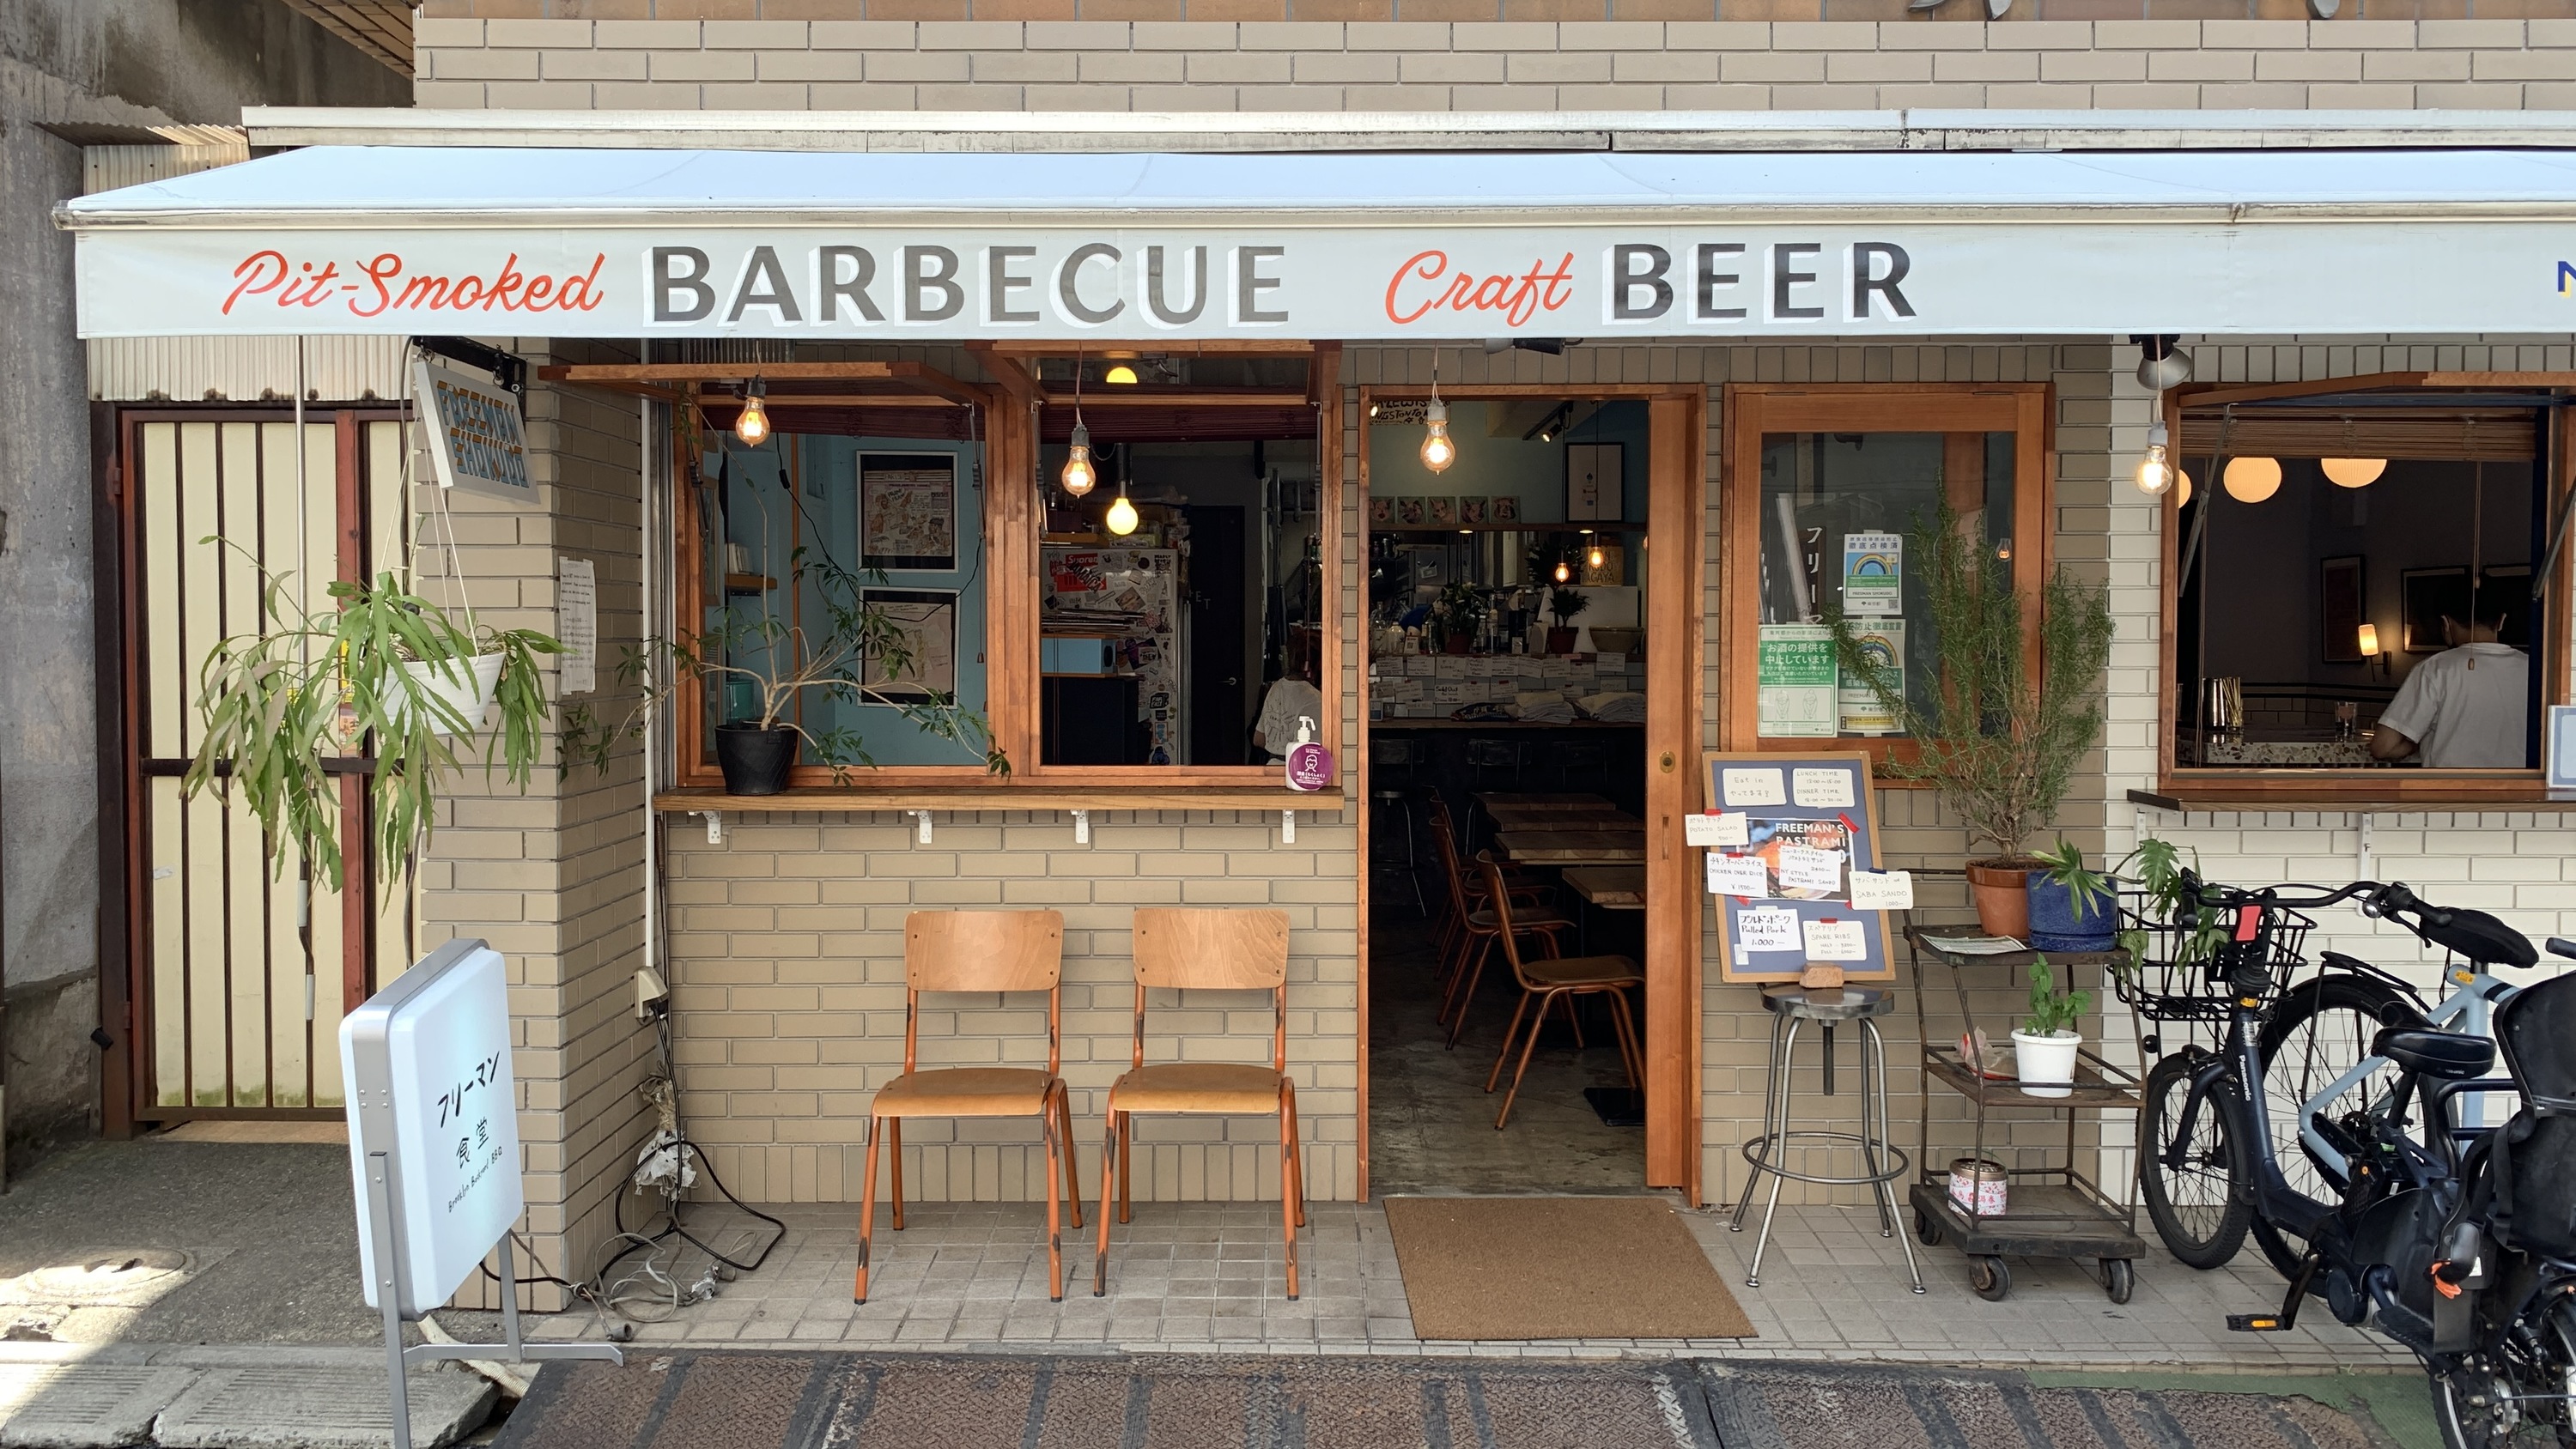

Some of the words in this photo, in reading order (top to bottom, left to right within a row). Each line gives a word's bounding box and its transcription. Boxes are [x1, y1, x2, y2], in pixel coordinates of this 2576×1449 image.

[222, 250, 605, 317] Pit-Smoked
[646, 243, 1289, 325] BARBECUE
[1384, 250, 1574, 328] Craft
[1606, 242, 1916, 324] BEER
[436, 379, 523, 446] FREEMAN
[449, 427, 531, 489] SHOKUDO
[1765, 654, 1830, 664] 中止しています
[1767, 643, 1828, 652] お酒の提供を
[1775, 822, 1844, 834] FREEMAN'S
[1776, 836, 1846, 847] PASTRAMI
[1710, 857, 1763, 868] チキンオーバーライス
[1788, 876, 1814, 884] PASTRAMI
[1856, 890, 1877, 899] SABA
[1880, 889, 1907, 898] SANDO
[1741, 925, 1764, 935] Pulled
[1766, 925, 1787, 934] Pork
[437, 1050, 500, 1128] フリーマン
[2239, 1054, 2252, 1101] Panasonic
[455, 1116, 489, 1169] 食堂
[448, 1183, 470, 1213] Brooklyn
[491, 1146, 502, 1164] BBQ
